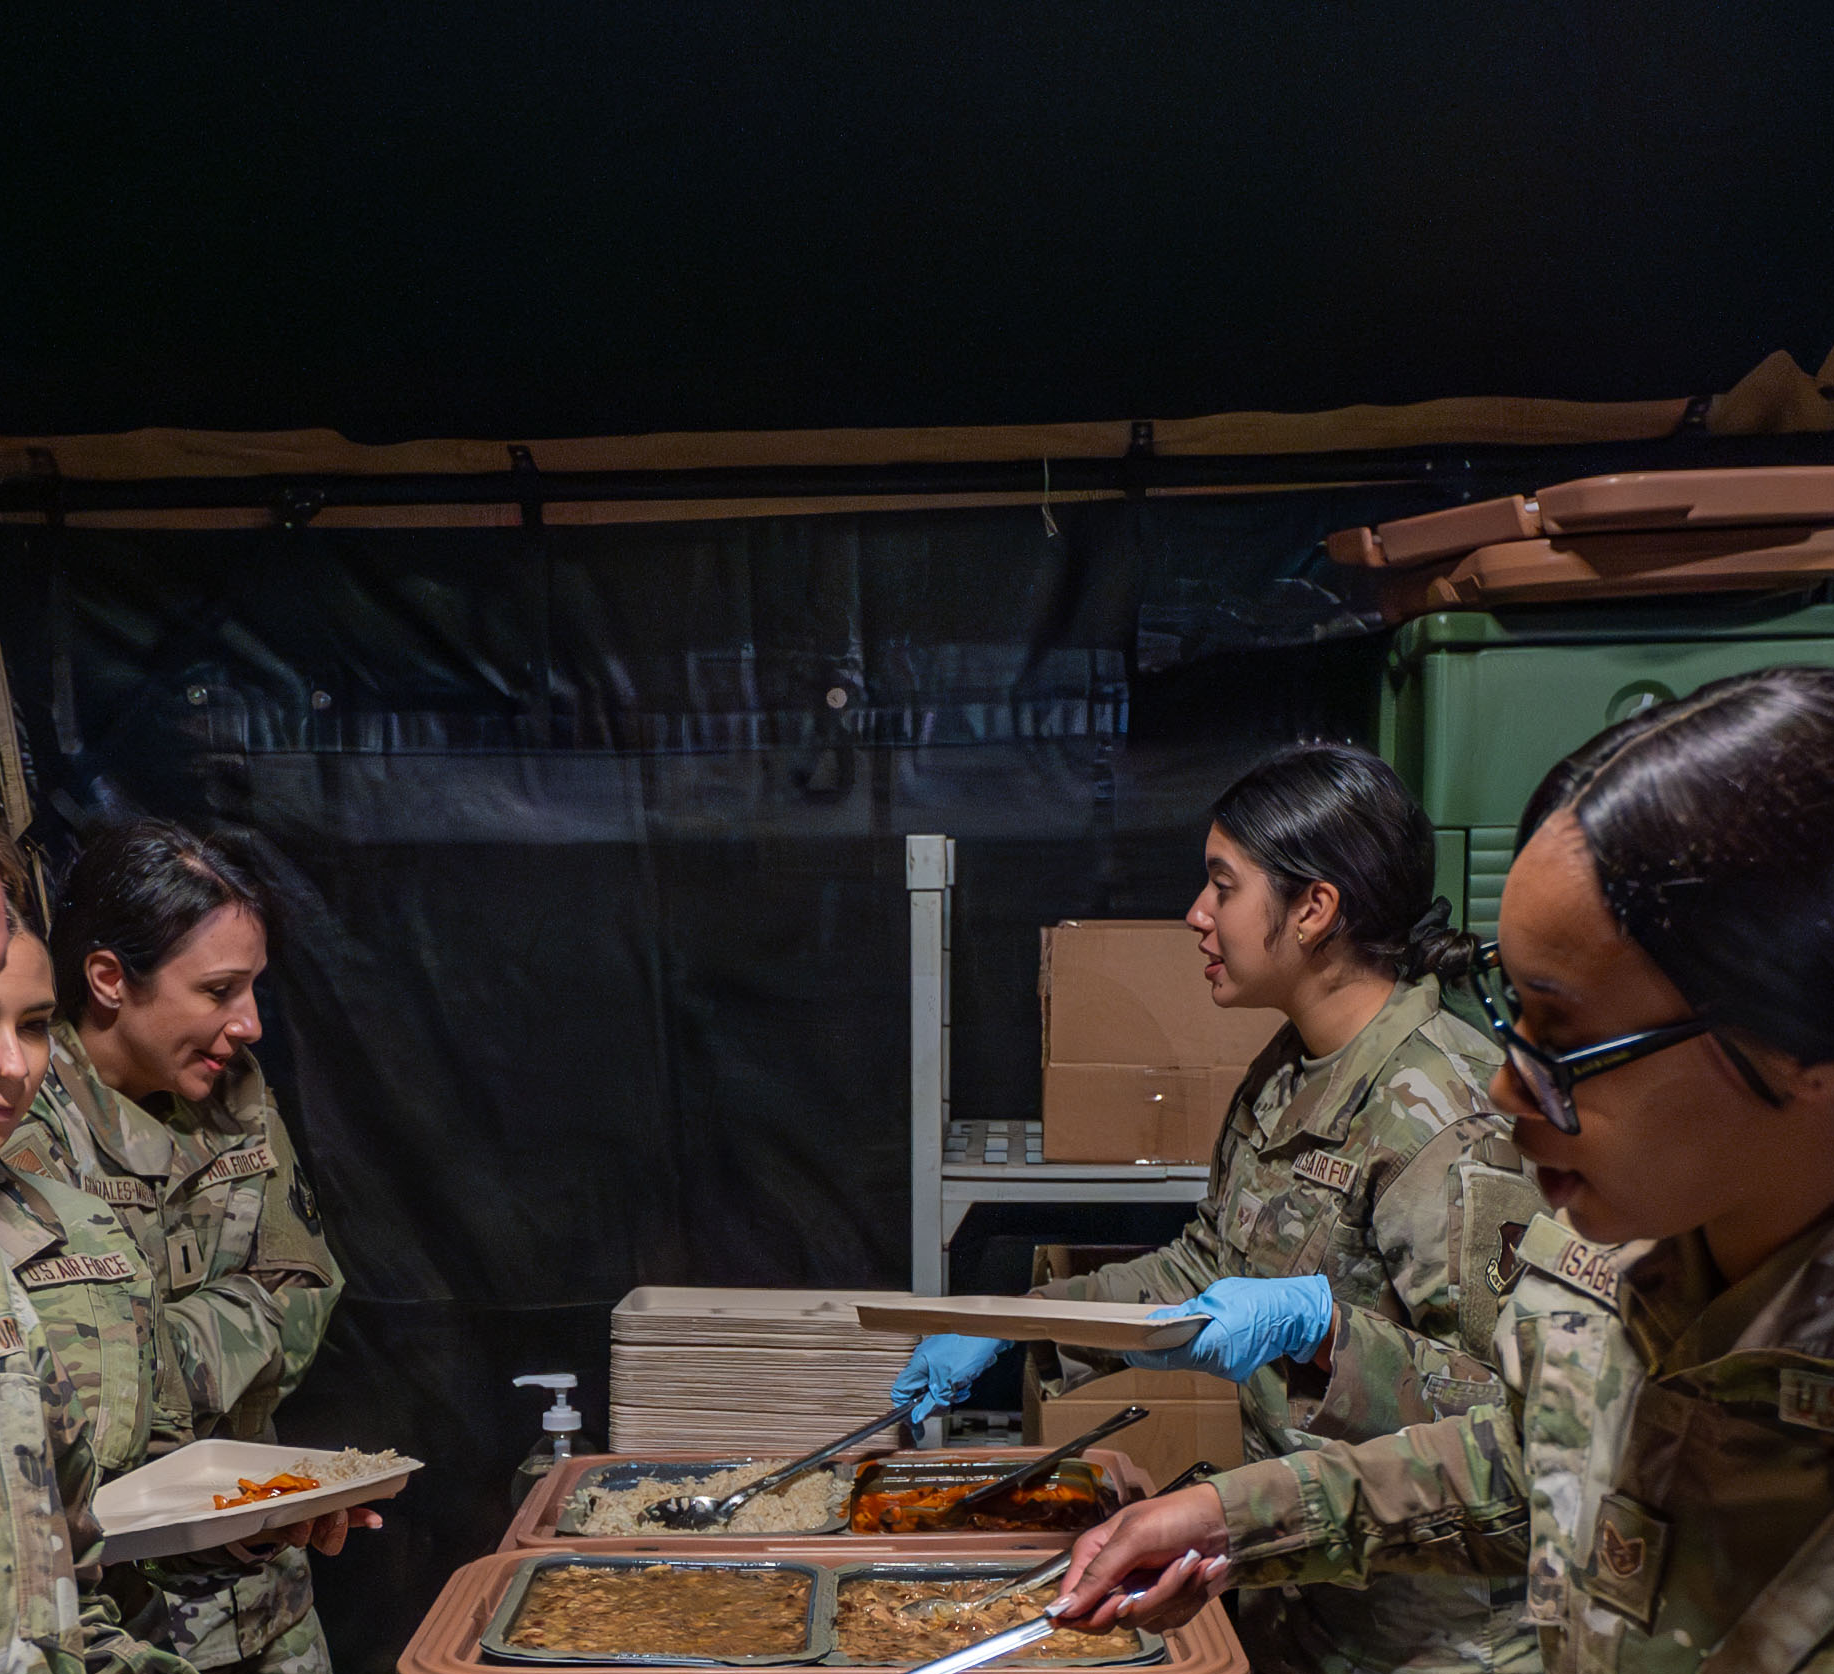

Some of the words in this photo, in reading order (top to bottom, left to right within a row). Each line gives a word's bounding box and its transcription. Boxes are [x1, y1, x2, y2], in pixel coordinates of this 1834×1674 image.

[229, 1149, 270, 1176] FORCE
[1328, 1160, 1354, 1186] FO
[27, 1262, 60, 1283] U.S.
[55, 1257, 83, 1280] AIR
[81, 1253, 131, 1278] FORCE
